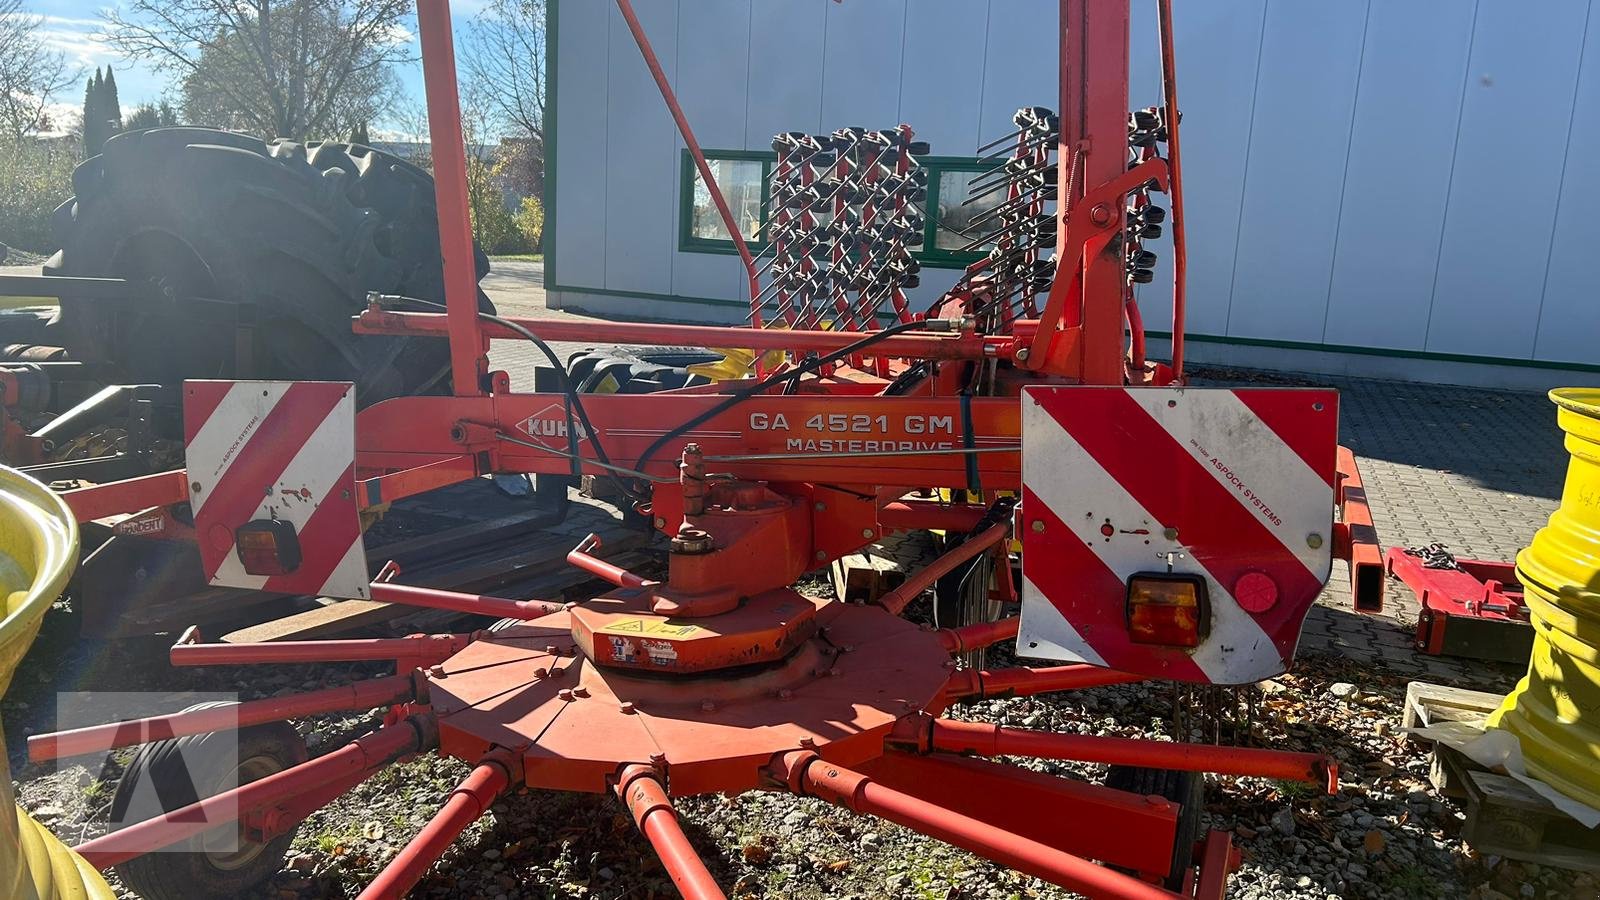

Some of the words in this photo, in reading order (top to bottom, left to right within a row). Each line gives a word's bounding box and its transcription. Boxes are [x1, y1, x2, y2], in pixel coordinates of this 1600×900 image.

[527, 417, 587, 439] KUHN
[749, 412, 790, 431] GA
[806, 413, 888, 433] 4521
[904, 415, 953, 434] GM
[786, 438, 953, 453] MASTERDRIVE
[1243, 489, 1282, 527] SYSTEMS
